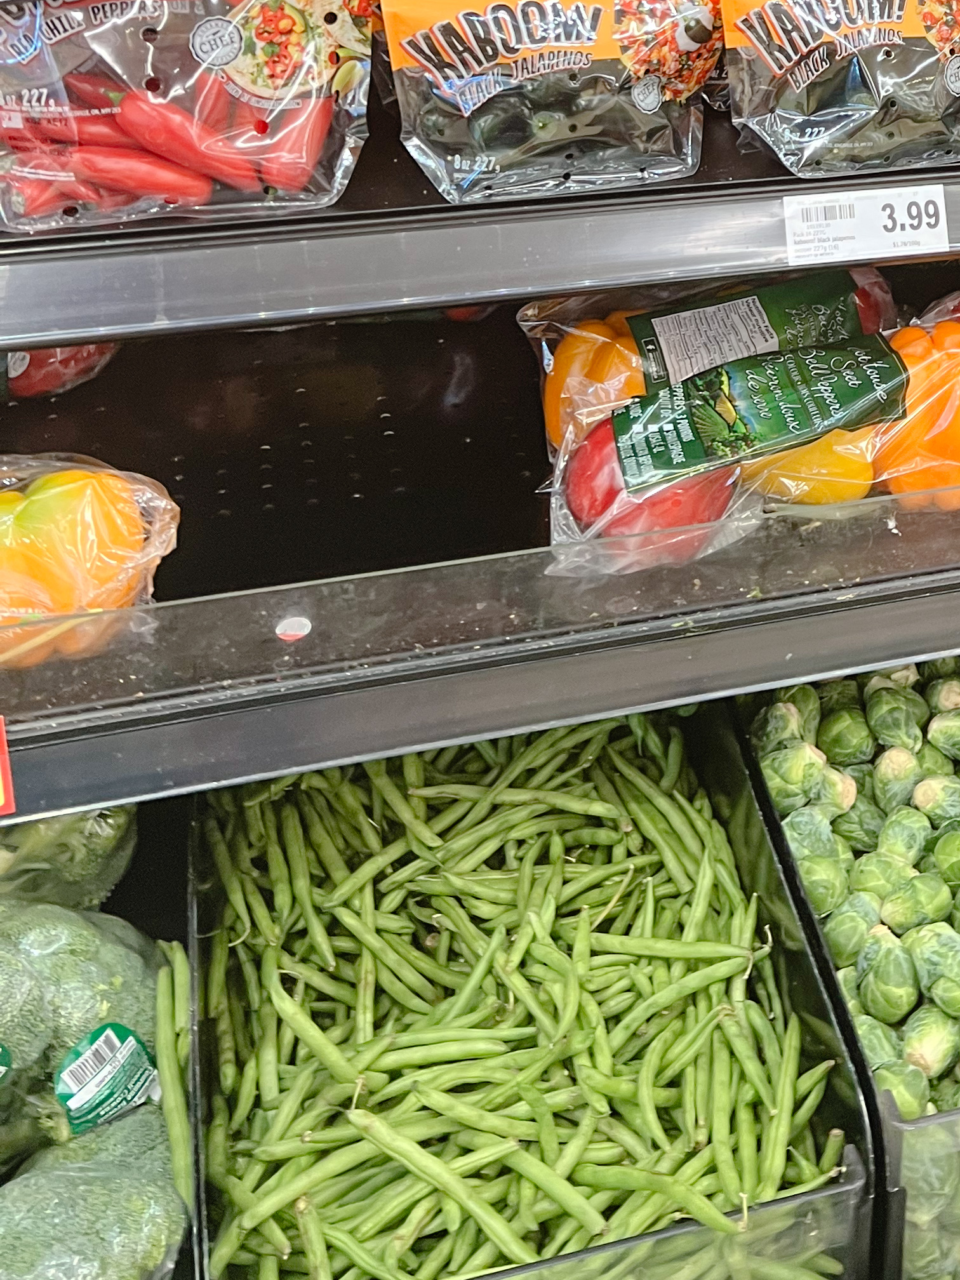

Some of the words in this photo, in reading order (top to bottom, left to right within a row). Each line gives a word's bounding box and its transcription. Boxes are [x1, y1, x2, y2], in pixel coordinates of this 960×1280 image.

[199, 31, 237, 55] CHEF
[792, 47, 829, 90] BLACK
[881, 199, 940, 234] 3.99
[751, 297, 766, 325] Nutrition
[755, 319, 769, 344] nutritive
[743, 365, 768, 394] de
[778, 396, 809, 437] doux
